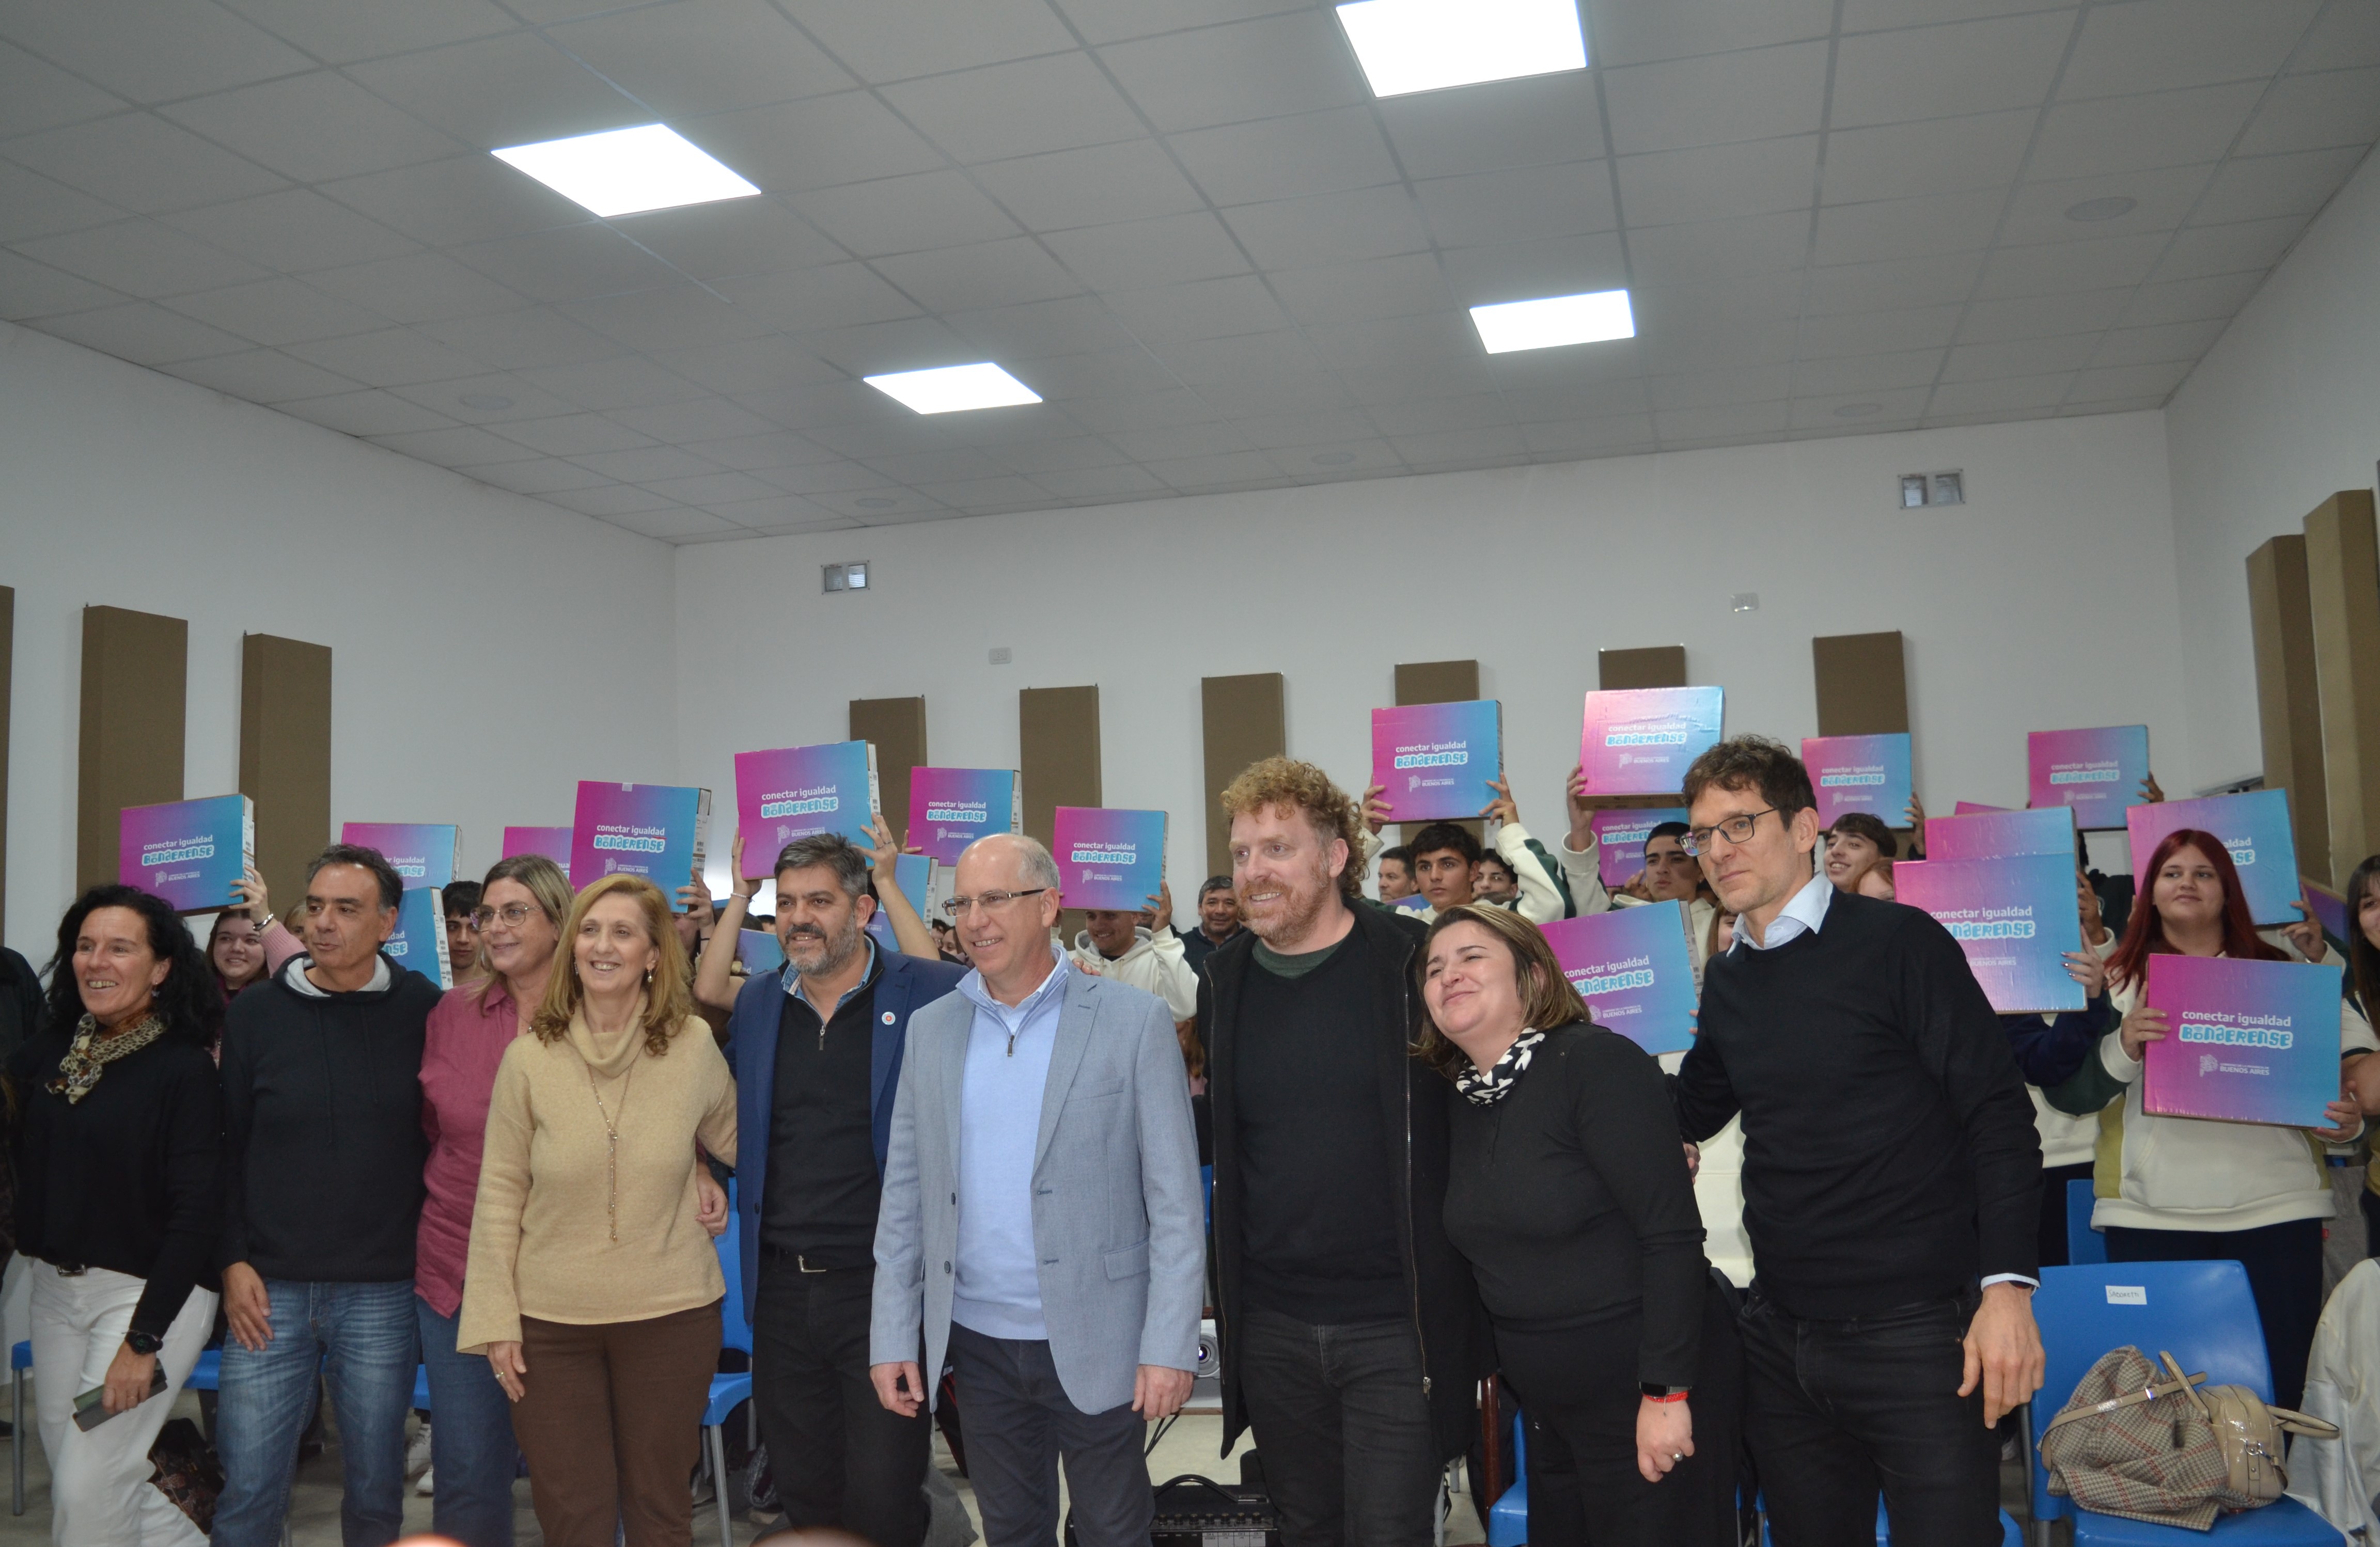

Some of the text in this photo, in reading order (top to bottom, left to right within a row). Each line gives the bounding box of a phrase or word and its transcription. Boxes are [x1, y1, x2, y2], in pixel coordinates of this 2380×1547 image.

[1648, 722, 1686, 732] igualdad
[1396, 740, 1466, 752] conectar igualdad
[762, 785, 836, 800] conectar igualdad
[597, 825, 665, 836] conectar igualdad
[144, 835, 213, 850] conectar igualdad
[1105, 843, 1135, 851] igualdad
[2222, 836, 2252, 848] aldad
[394, 857, 425, 865] igualdad
[1931, 906, 2032, 920] conectar igualdad
[1564, 955, 1649, 978] conectar igualdad
[1603, 1010, 1625, 1018] BUENOS
[2182, 1011, 2291, 1027] conectar igualdad
[2220, 1065, 2248, 1074] BUENOS
